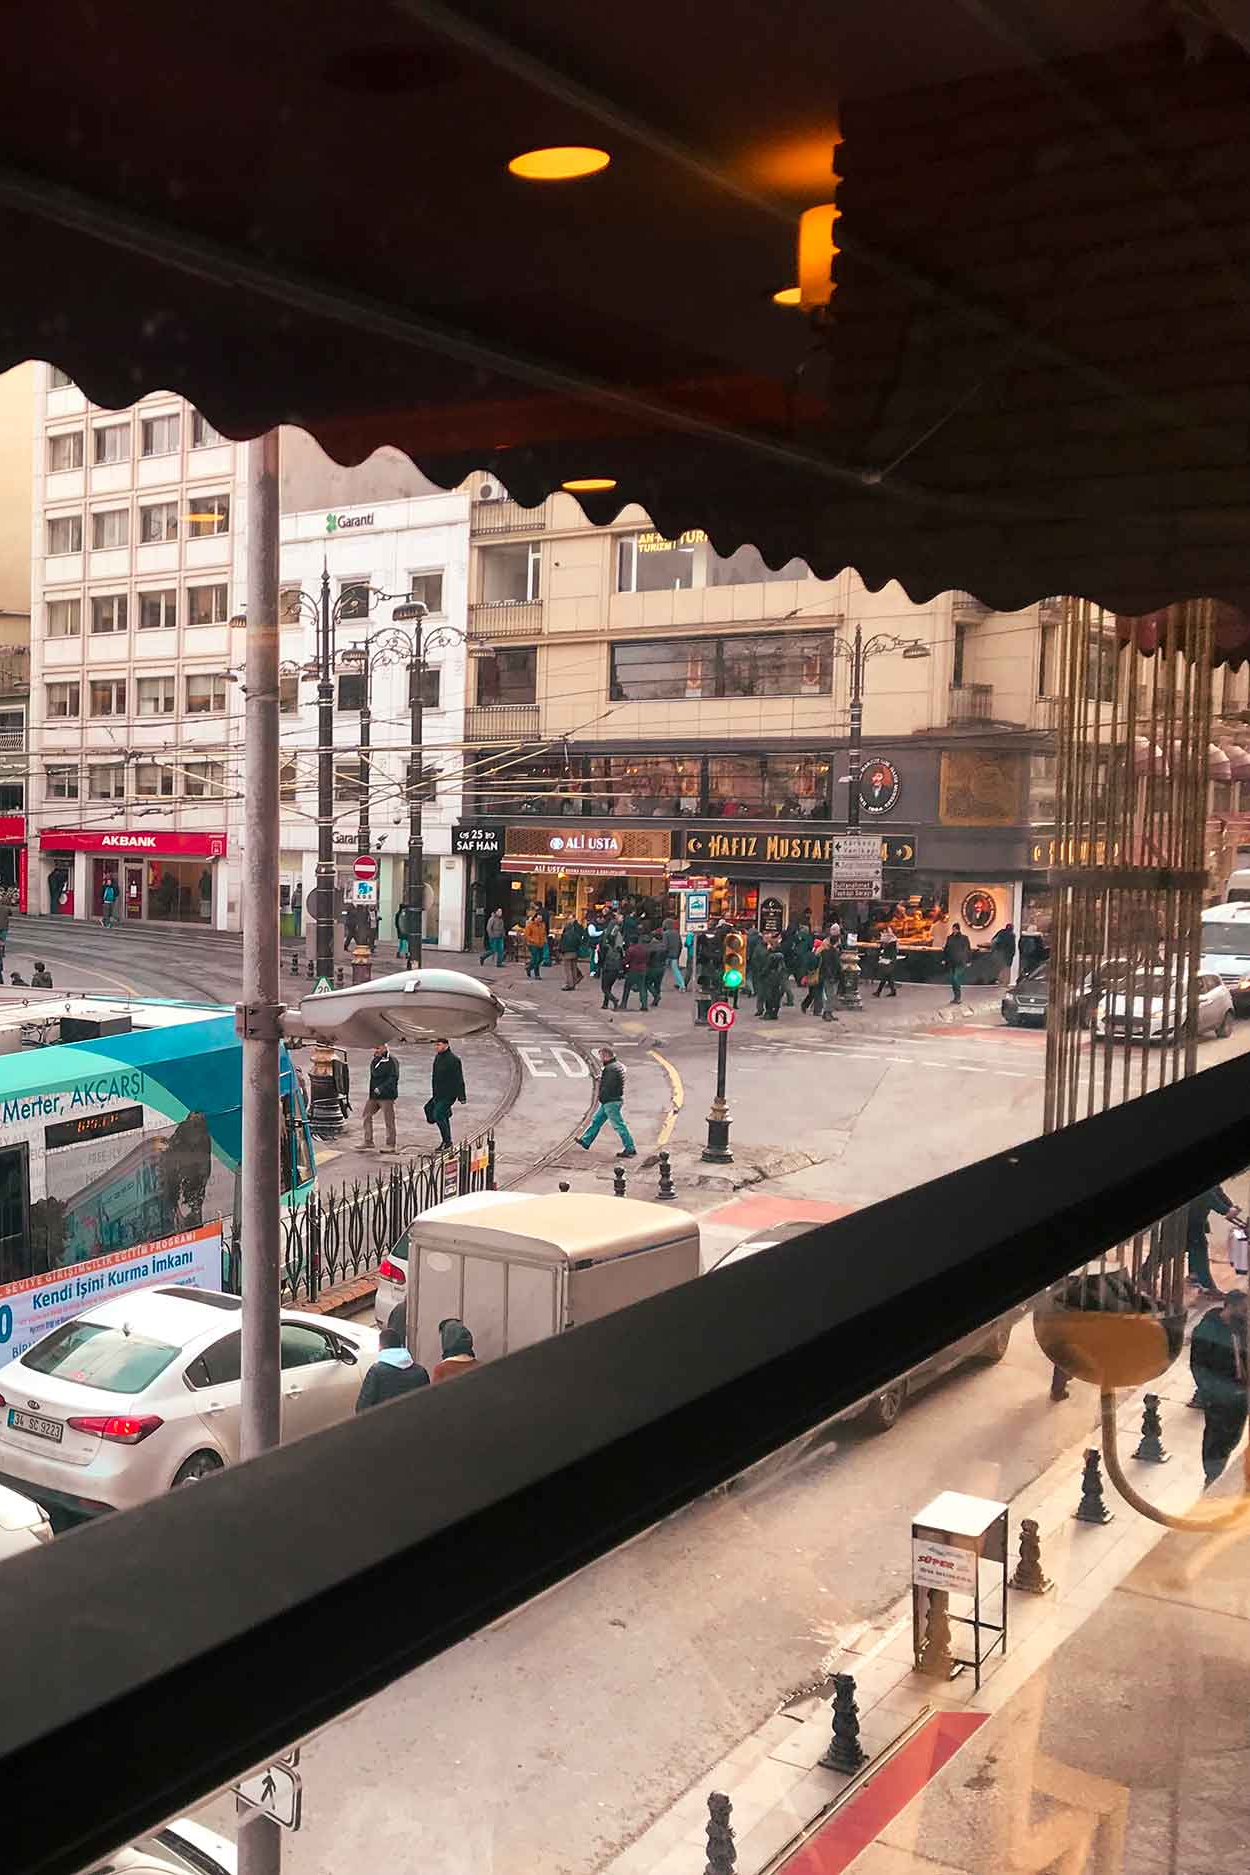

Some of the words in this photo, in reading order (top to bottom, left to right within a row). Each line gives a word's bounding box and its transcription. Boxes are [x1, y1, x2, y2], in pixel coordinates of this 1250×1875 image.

[337, 512, 375, 530] Garanti
[101, 834, 157, 848] AKBANK
[470, 829, 483, 839] 25
[565, 834, 586, 849] ALİ
[588, 837, 619, 850] USTA
[456, 840, 475, 851] SAF
[476, 841, 499, 851] HAN
[765, 835, 833, 861] MUSTAF
[2, 1092, 65, 1122] Merter,
[70, 1072, 145, 1109] AKÇARŞI
[149, 1231, 197, 1255] PROGRAMI
[32, 1282, 74, 1310] Kendi
[76, 1273, 105, 1298] İşini
[108, 1263, 149, 1288] Kurma
[151, 1249, 194, 1276] İmkanı
[14, 1413, 24, 1427] 34
[28, 1418, 39, 1431] SC
[40, 1423, 61, 1438] 9223
